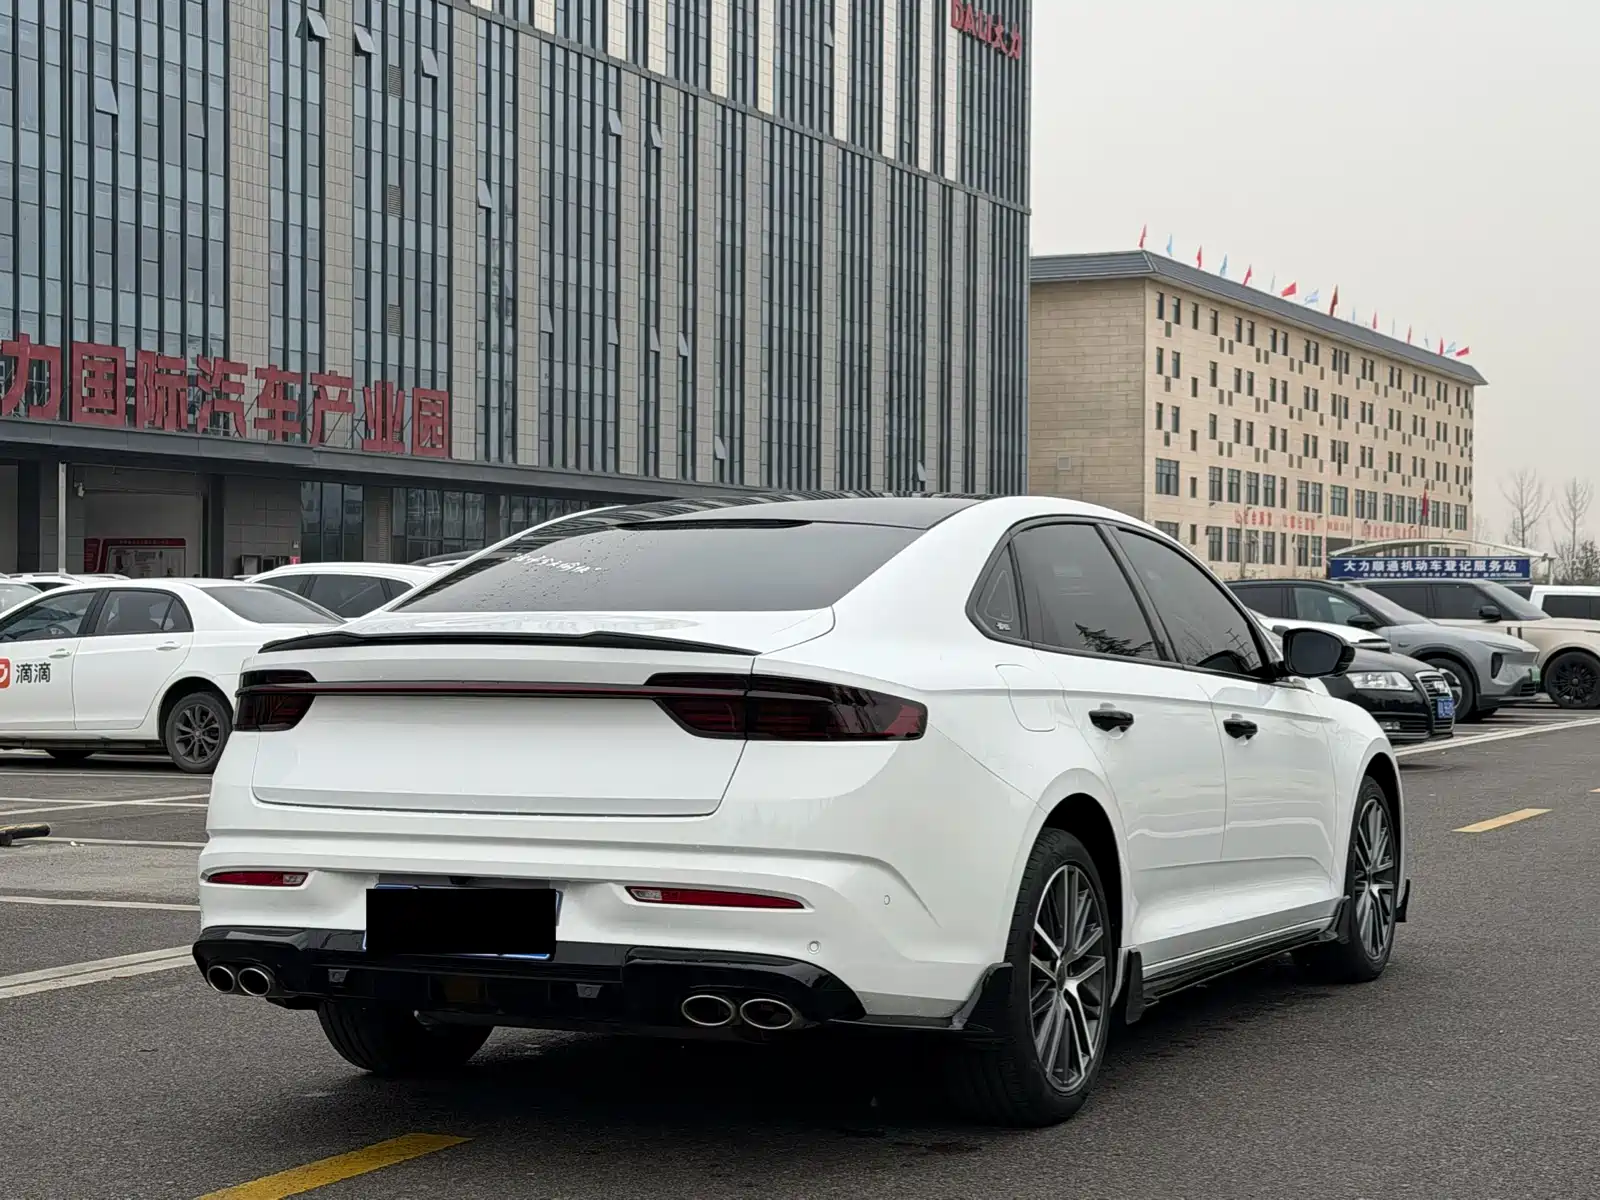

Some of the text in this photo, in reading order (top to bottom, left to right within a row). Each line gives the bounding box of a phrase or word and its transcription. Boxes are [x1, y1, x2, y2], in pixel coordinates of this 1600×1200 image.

[0, 333, 450, 458] 力国际汽车产业园
[16, 662, 51, 684] 滴滴
